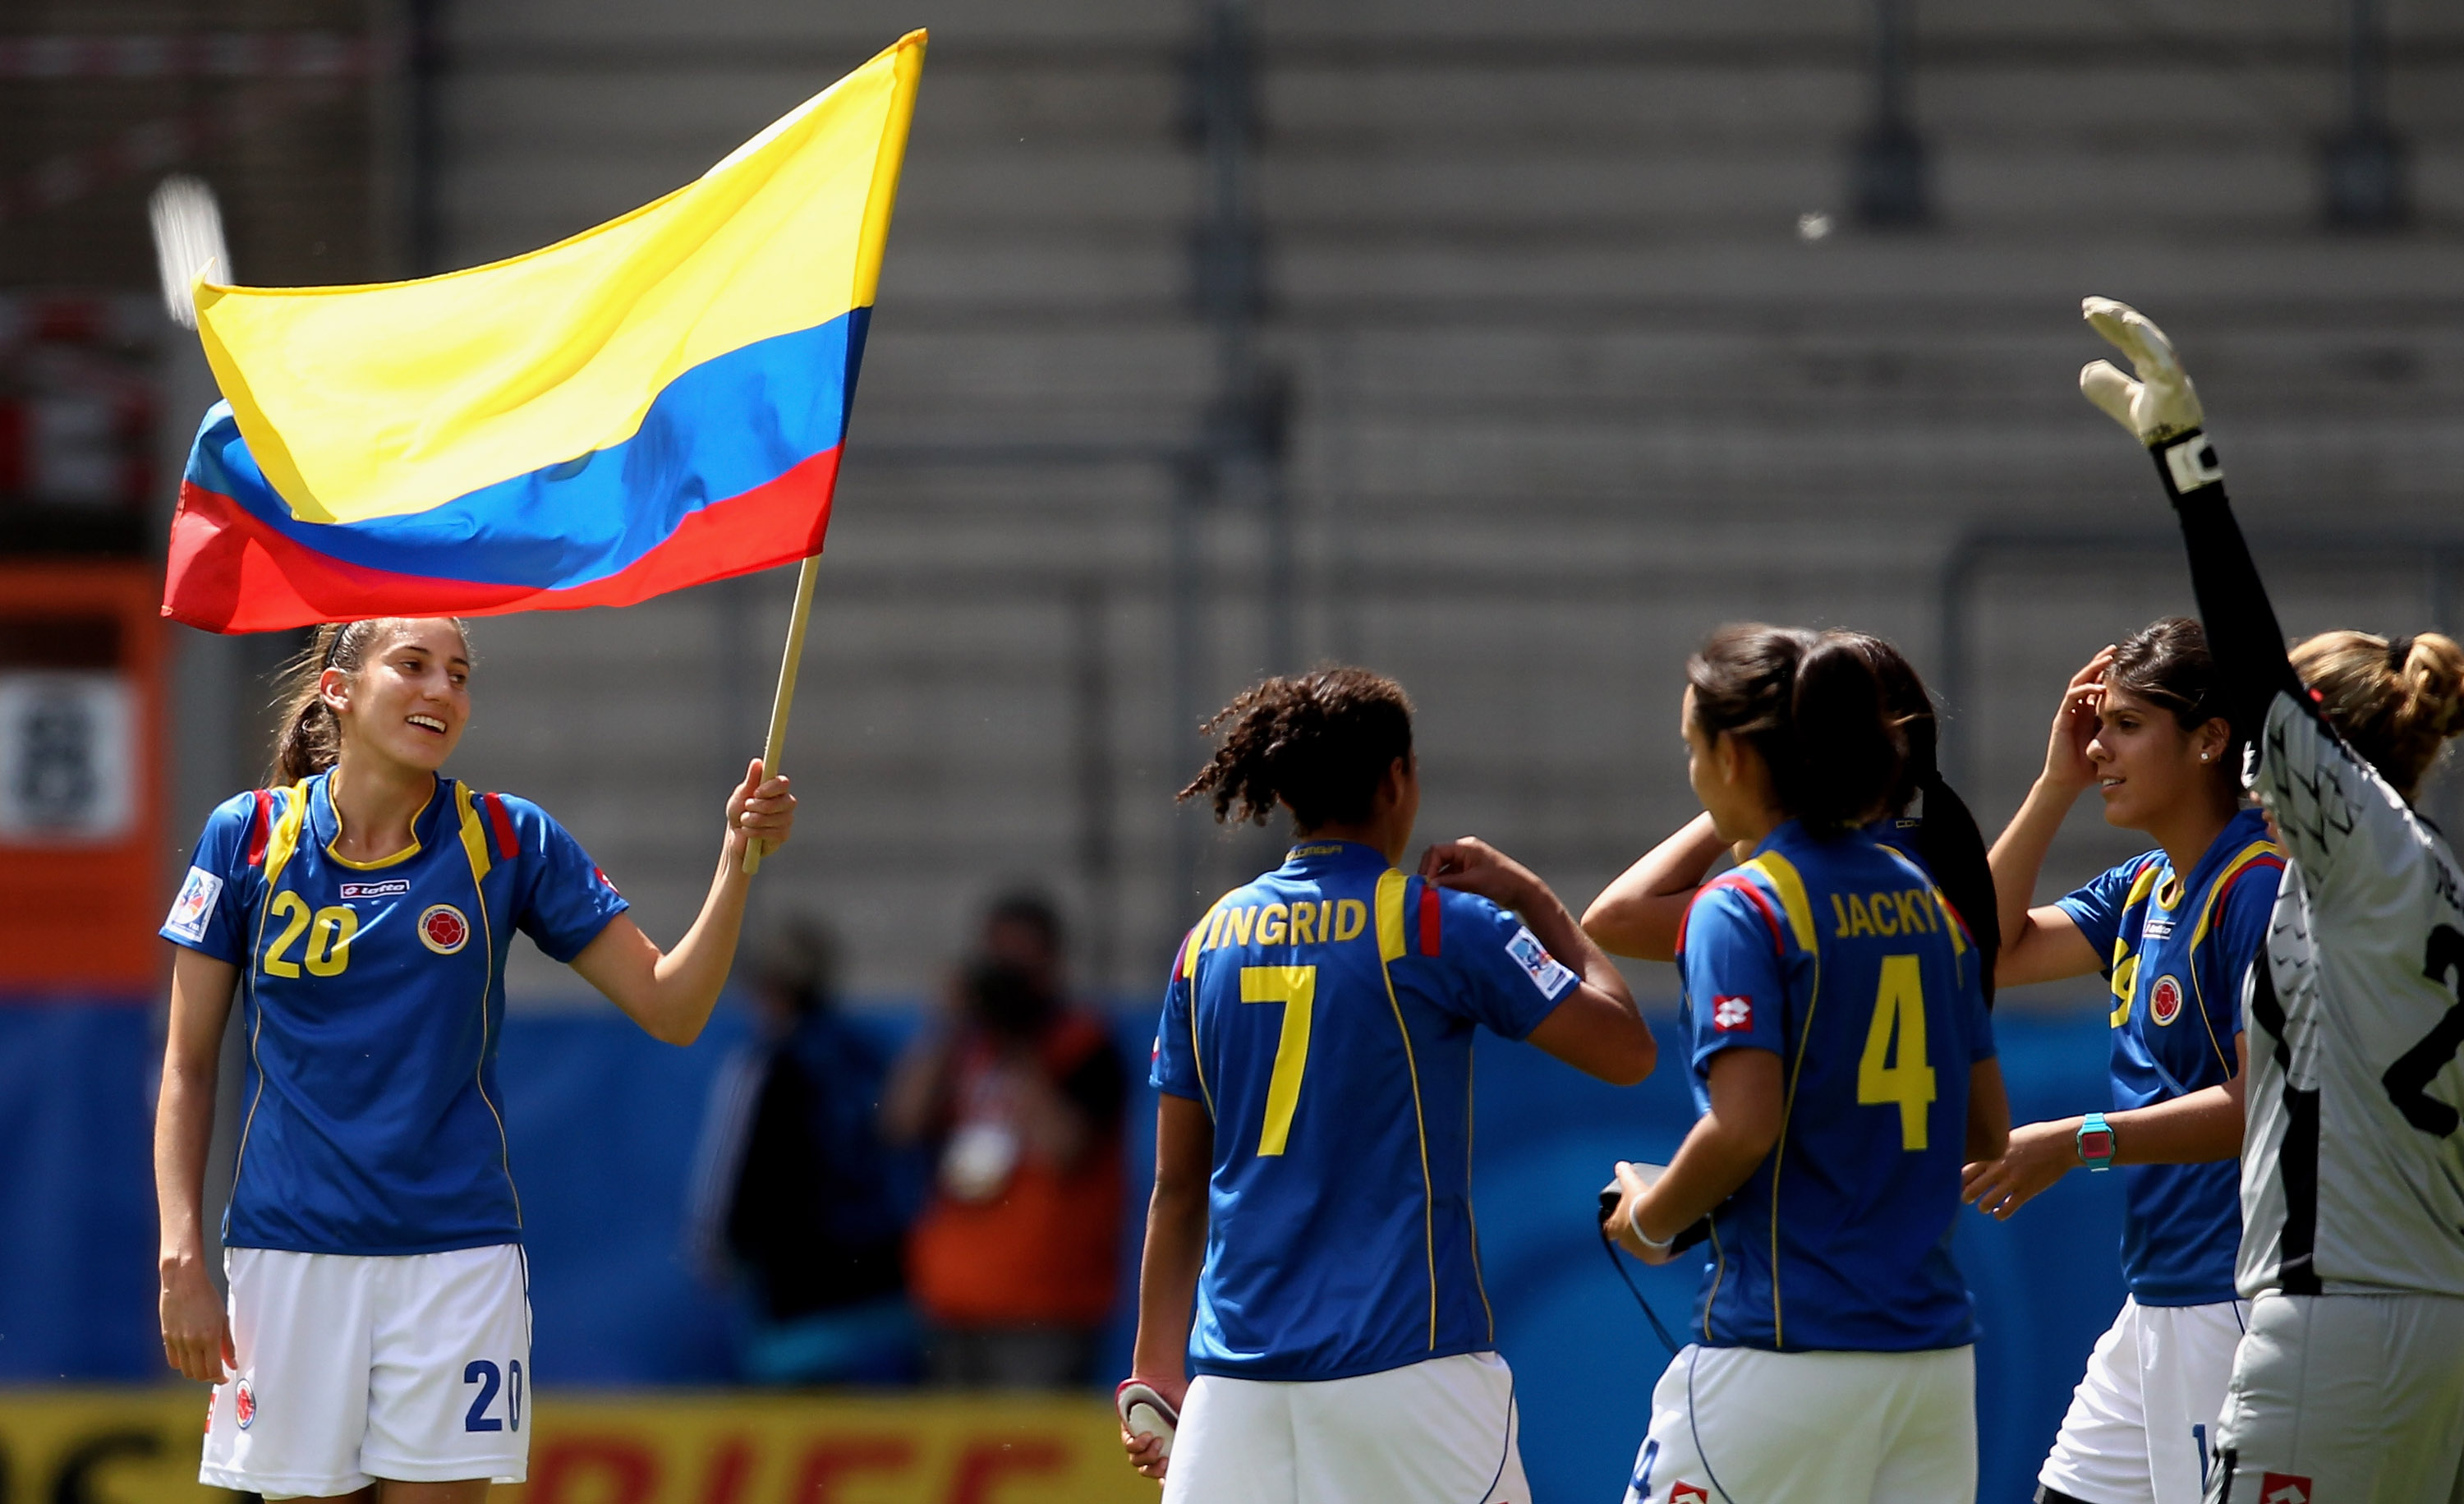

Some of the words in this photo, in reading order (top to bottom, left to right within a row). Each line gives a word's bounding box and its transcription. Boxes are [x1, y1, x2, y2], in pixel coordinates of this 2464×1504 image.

[361, 884, 405, 895] lotto
[1831, 889, 1938, 939] JACKY
[264, 890, 358, 978] 20
[1207, 899, 1368, 950] INGRID
[1240, 965, 1316, 1157] 7
[1857, 954, 1937, 1152] 4
[464, 1359, 523, 1433] 20
[1630, 1439, 1659, 1504] 4
